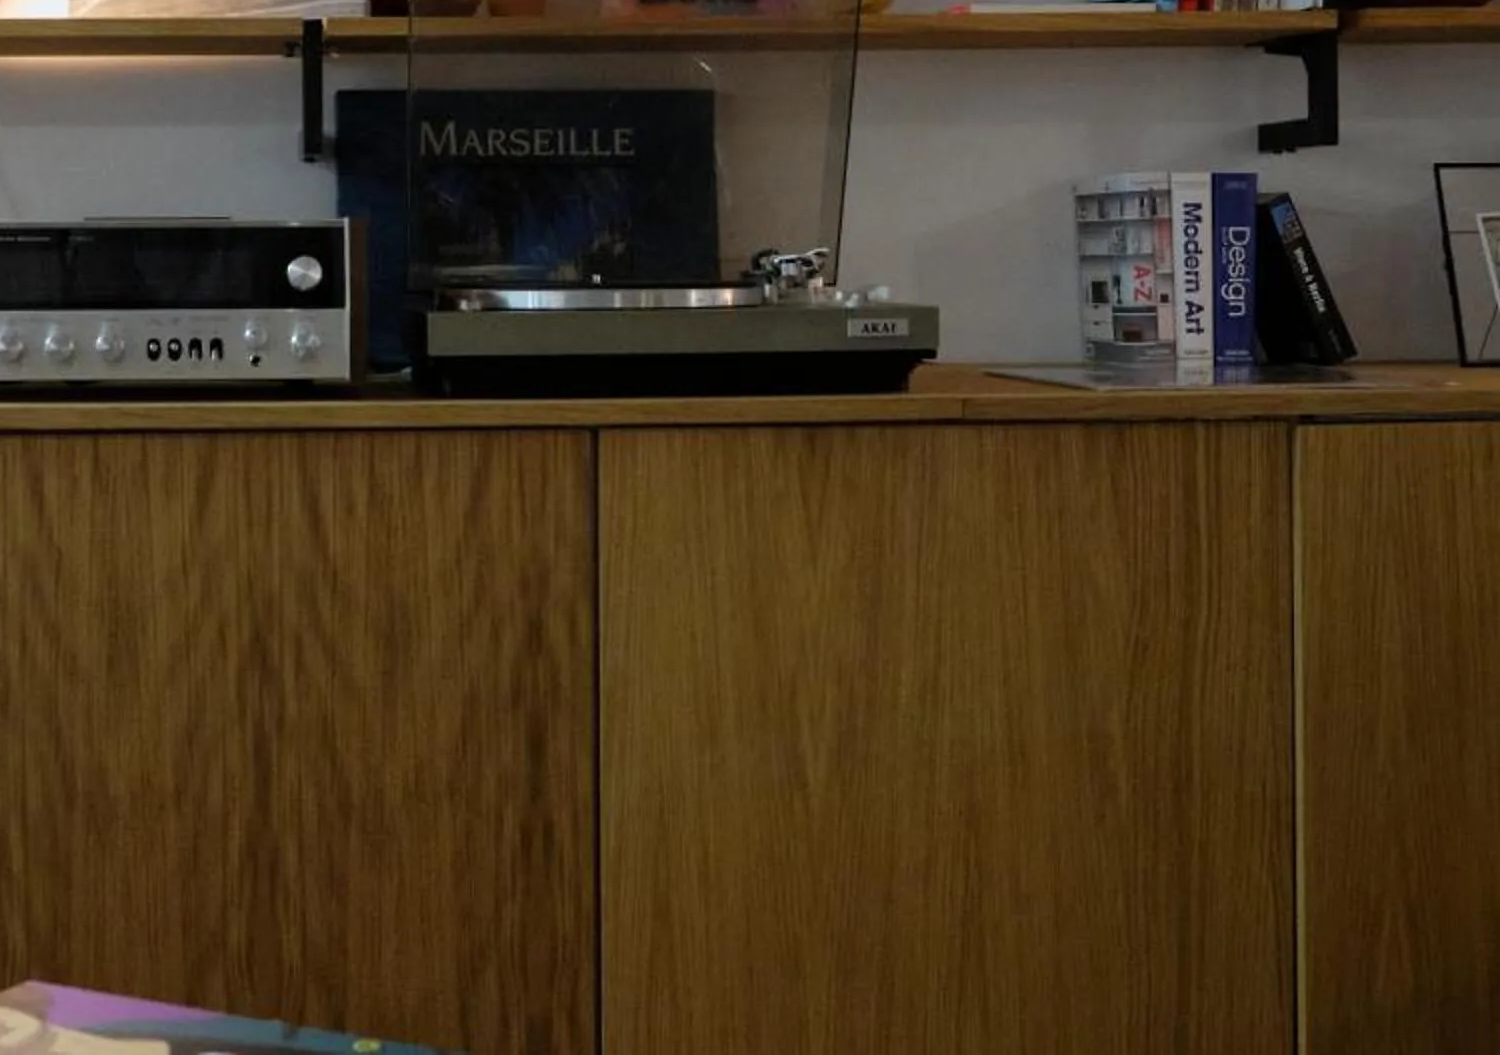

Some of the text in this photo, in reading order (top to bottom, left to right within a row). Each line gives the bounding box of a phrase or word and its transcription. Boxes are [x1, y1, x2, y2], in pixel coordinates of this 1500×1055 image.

[1182, 201, 1204, 293] Modern
[1220, 226, 1251, 318] Design
[861, 322, 897, 334] AKAI
[1184, 300, 1205, 336] Art
